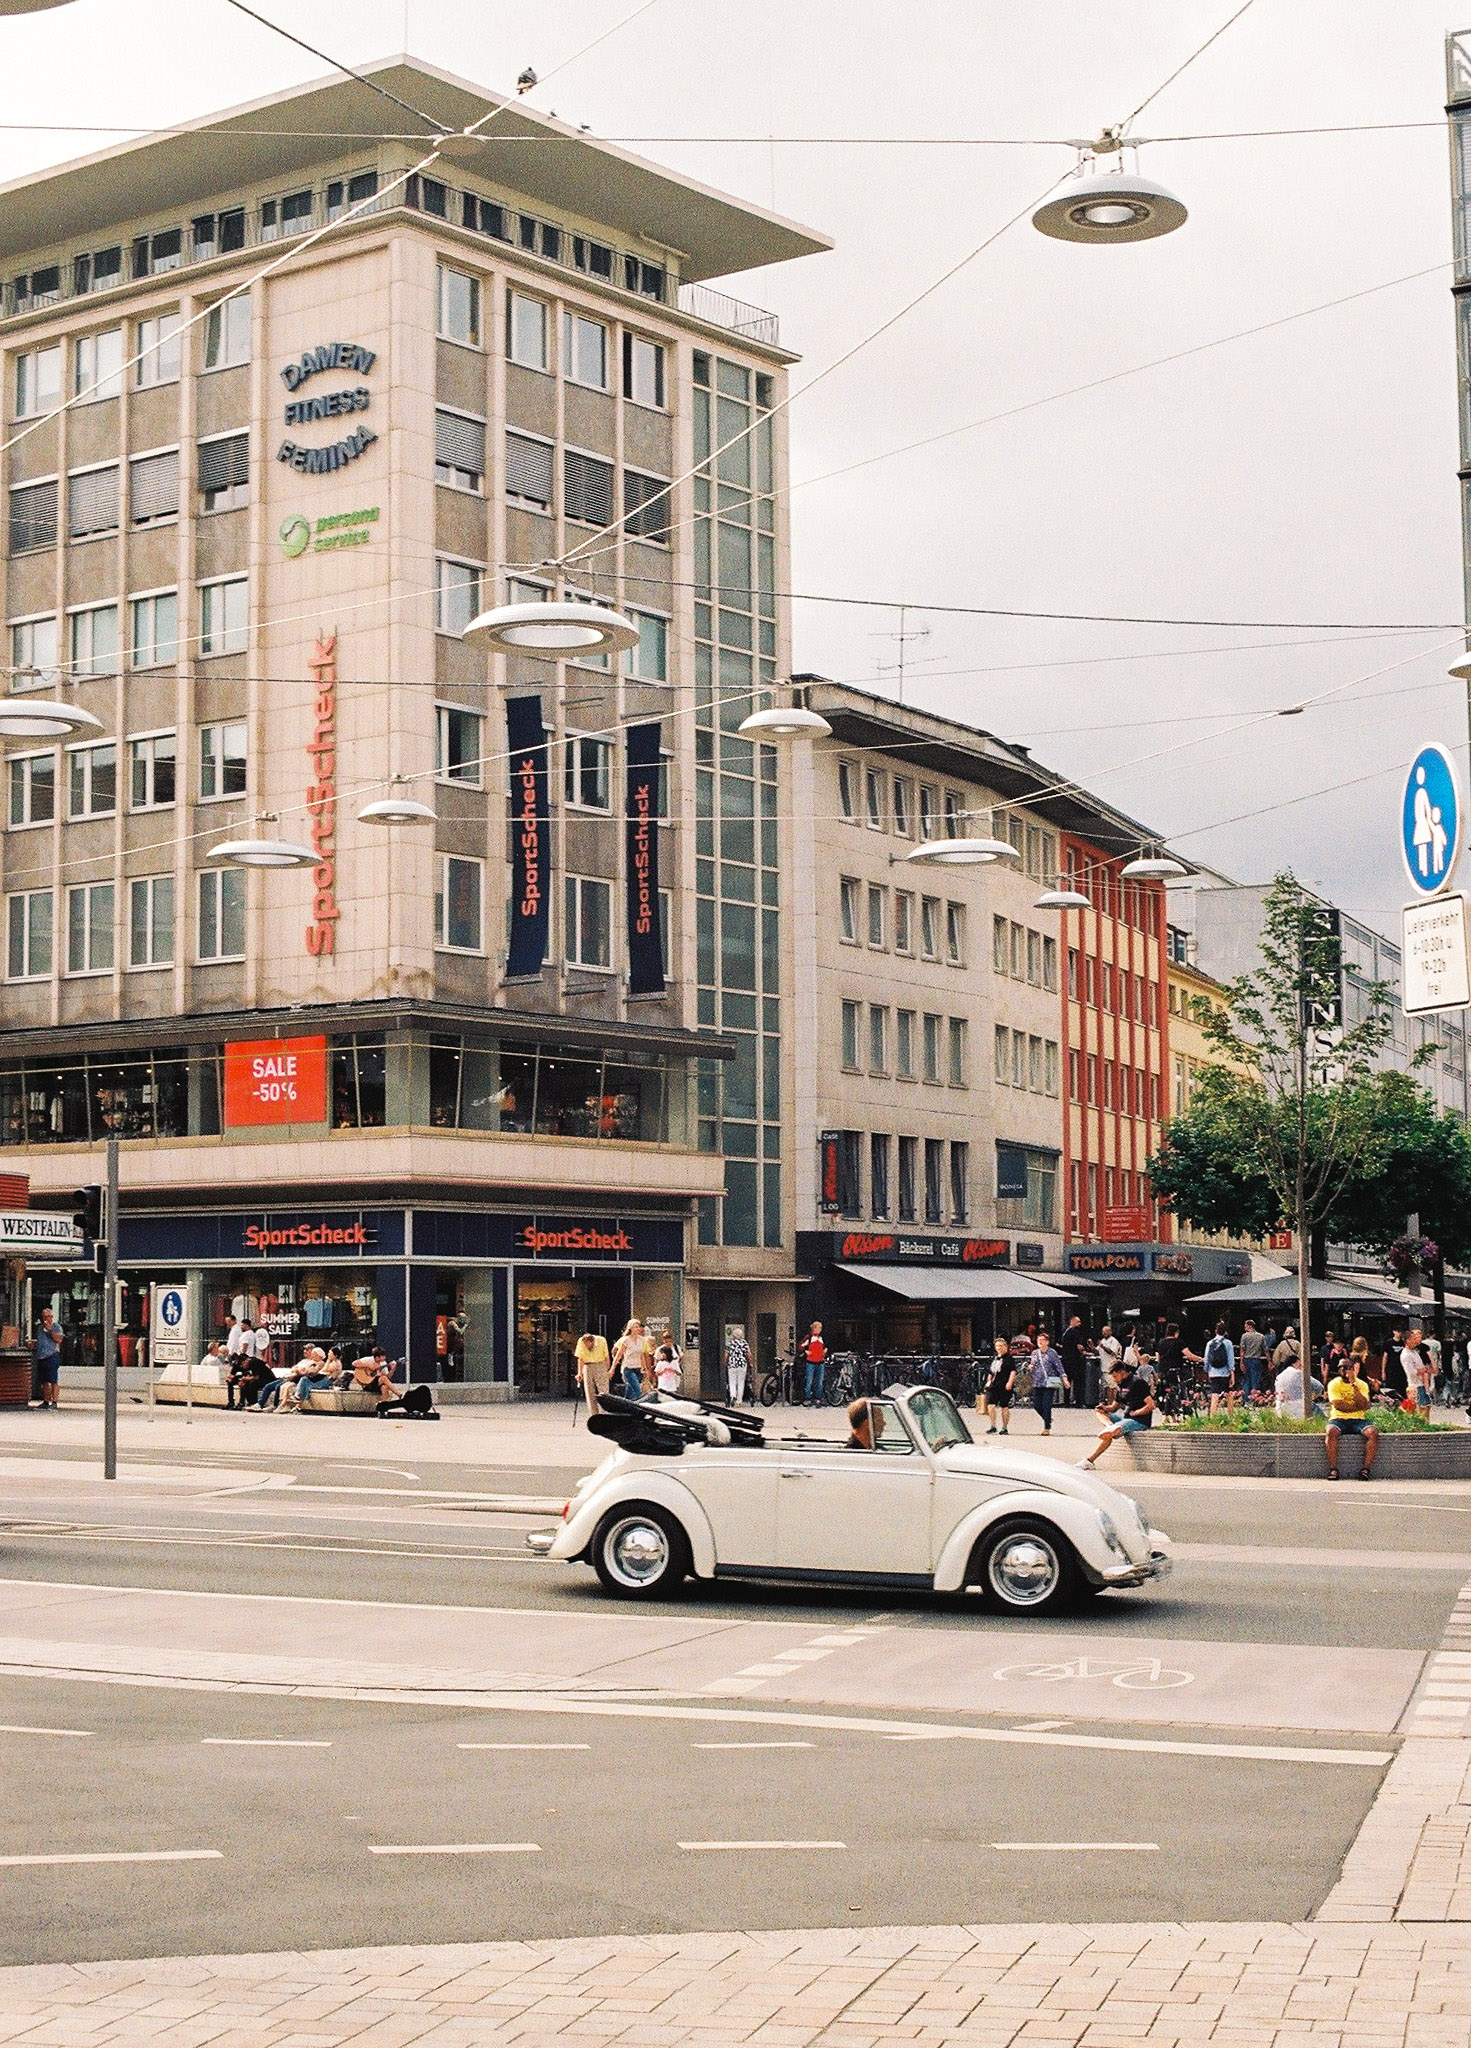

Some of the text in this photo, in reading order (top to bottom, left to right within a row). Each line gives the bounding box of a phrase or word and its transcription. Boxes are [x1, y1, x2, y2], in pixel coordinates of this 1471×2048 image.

[279, 342, 376, 392] DAMEN
[284, 386, 370, 426] FITNESS
[276, 425, 379, 475] FEMINA
[314, 529, 369, 553] service
[306, 634, 340, 956] SportScheck
[520, 758, 542, 917] SportScheck
[634, 783, 653, 935] SportScheck
[252, 1056, 297, 1079] SALE
[252, 1082, 297, 1102] -50%
[245, 1222, 368, 1250] SportScheck
[523, 1226, 633, 1251] SportScheck
[940, 1243, 960, 1256] Café
[259, 1312, 300, 1324] SUMMER
[268, 1324, 292, 1336] SALE
[163, 1327, 180, 1337] ZONE
